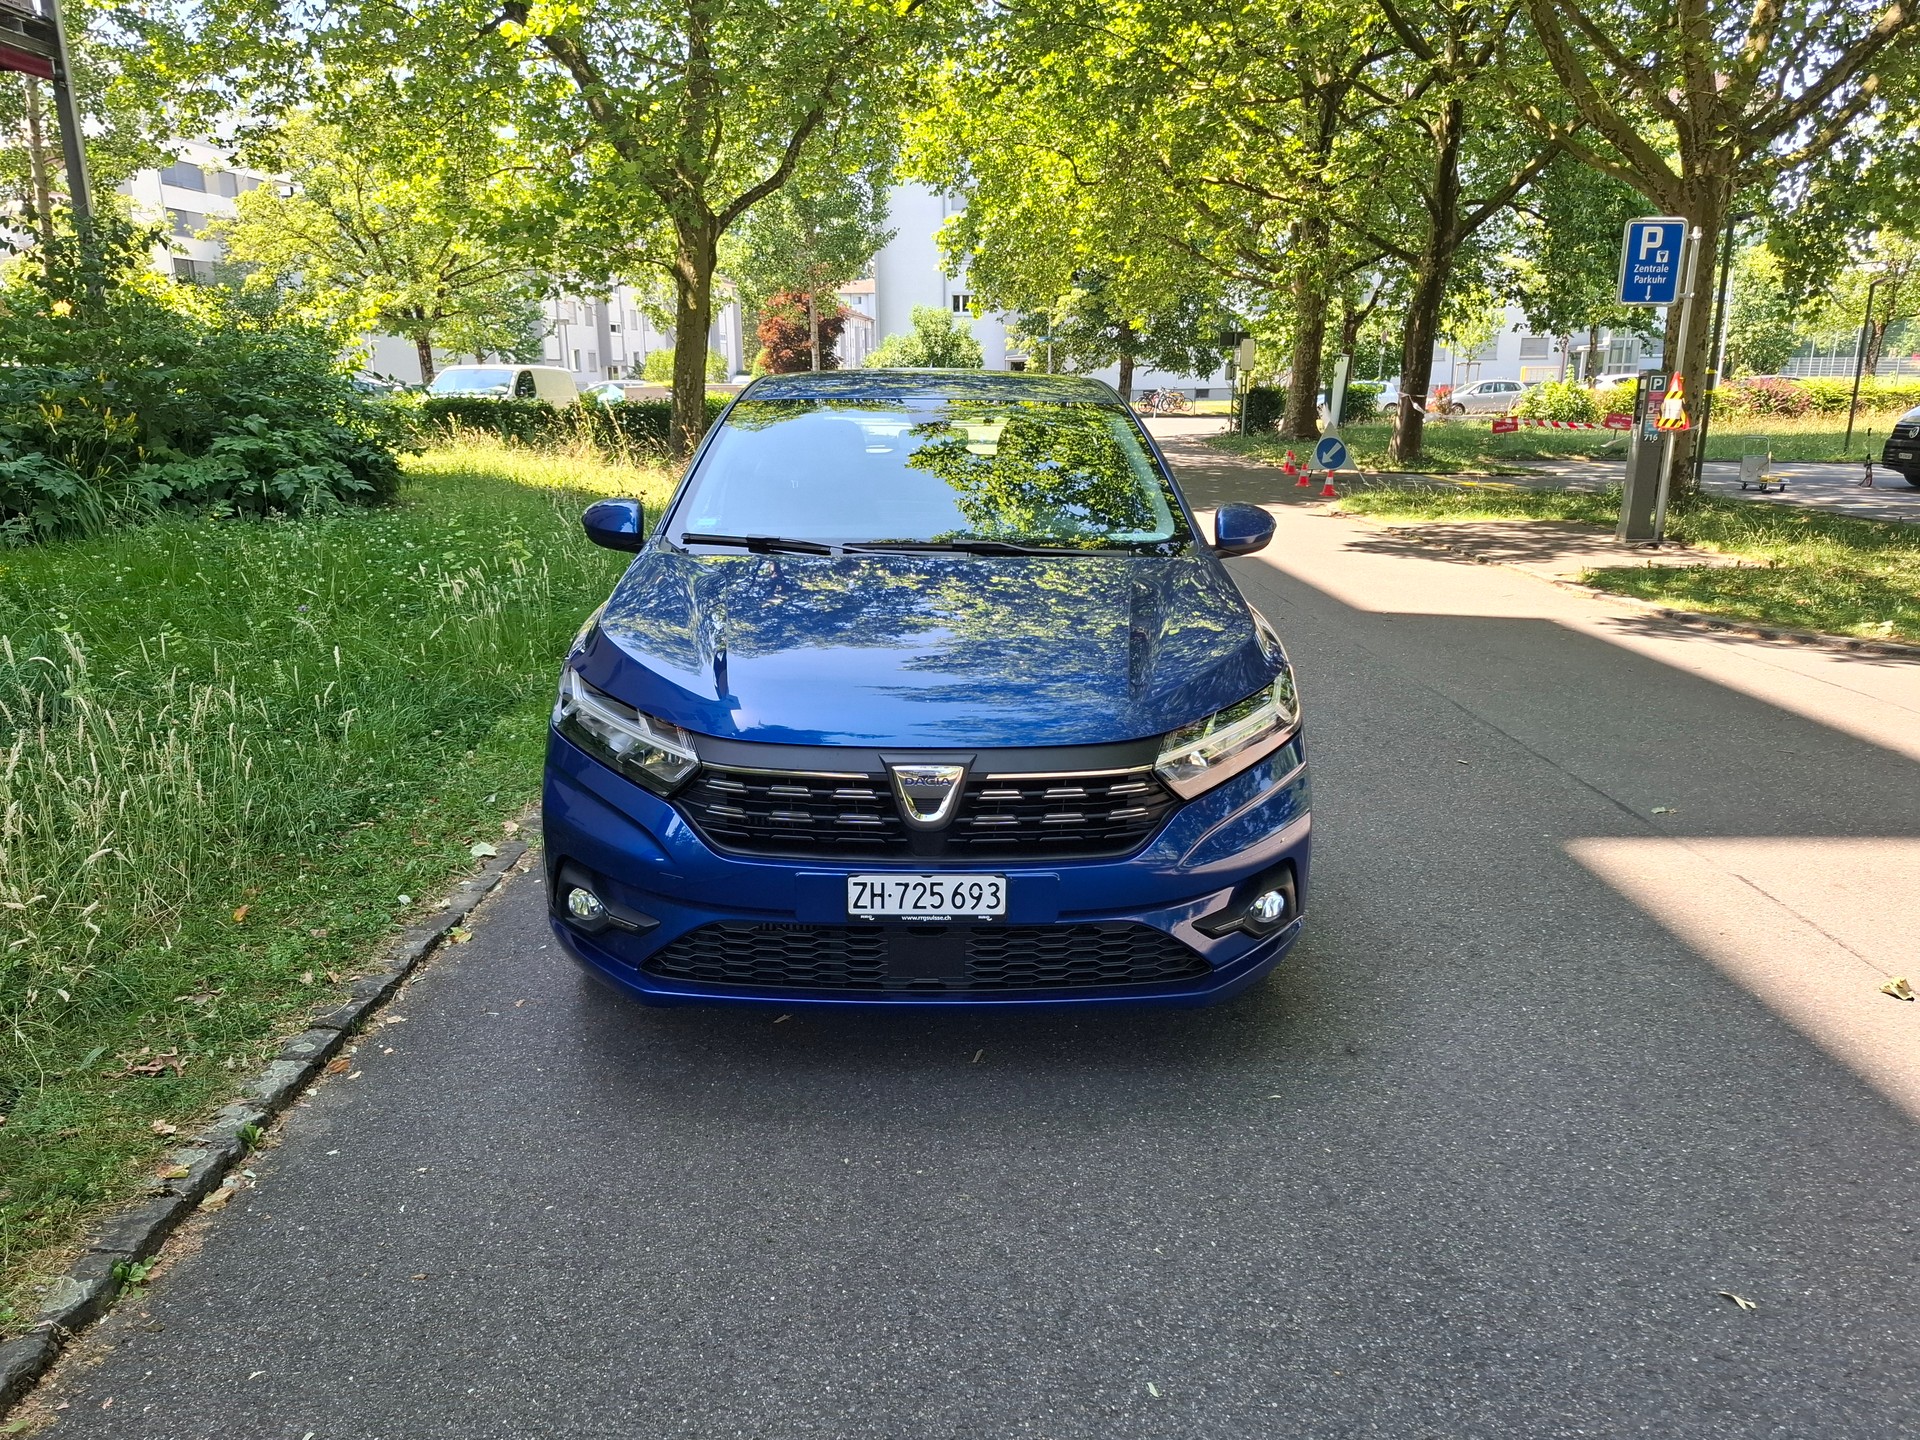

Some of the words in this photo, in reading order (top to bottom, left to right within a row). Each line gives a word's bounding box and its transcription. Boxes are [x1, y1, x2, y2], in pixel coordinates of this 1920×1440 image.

[1639, 226, 1664, 260] P
[1633, 264, 1669, 273] Zentrale
[1633, 275, 1667, 284] Parkuhr
[1652, 378, 1663, 390] P
[904, 777, 951, 787] DACIA
[951, 882, 1001, 910] 693
